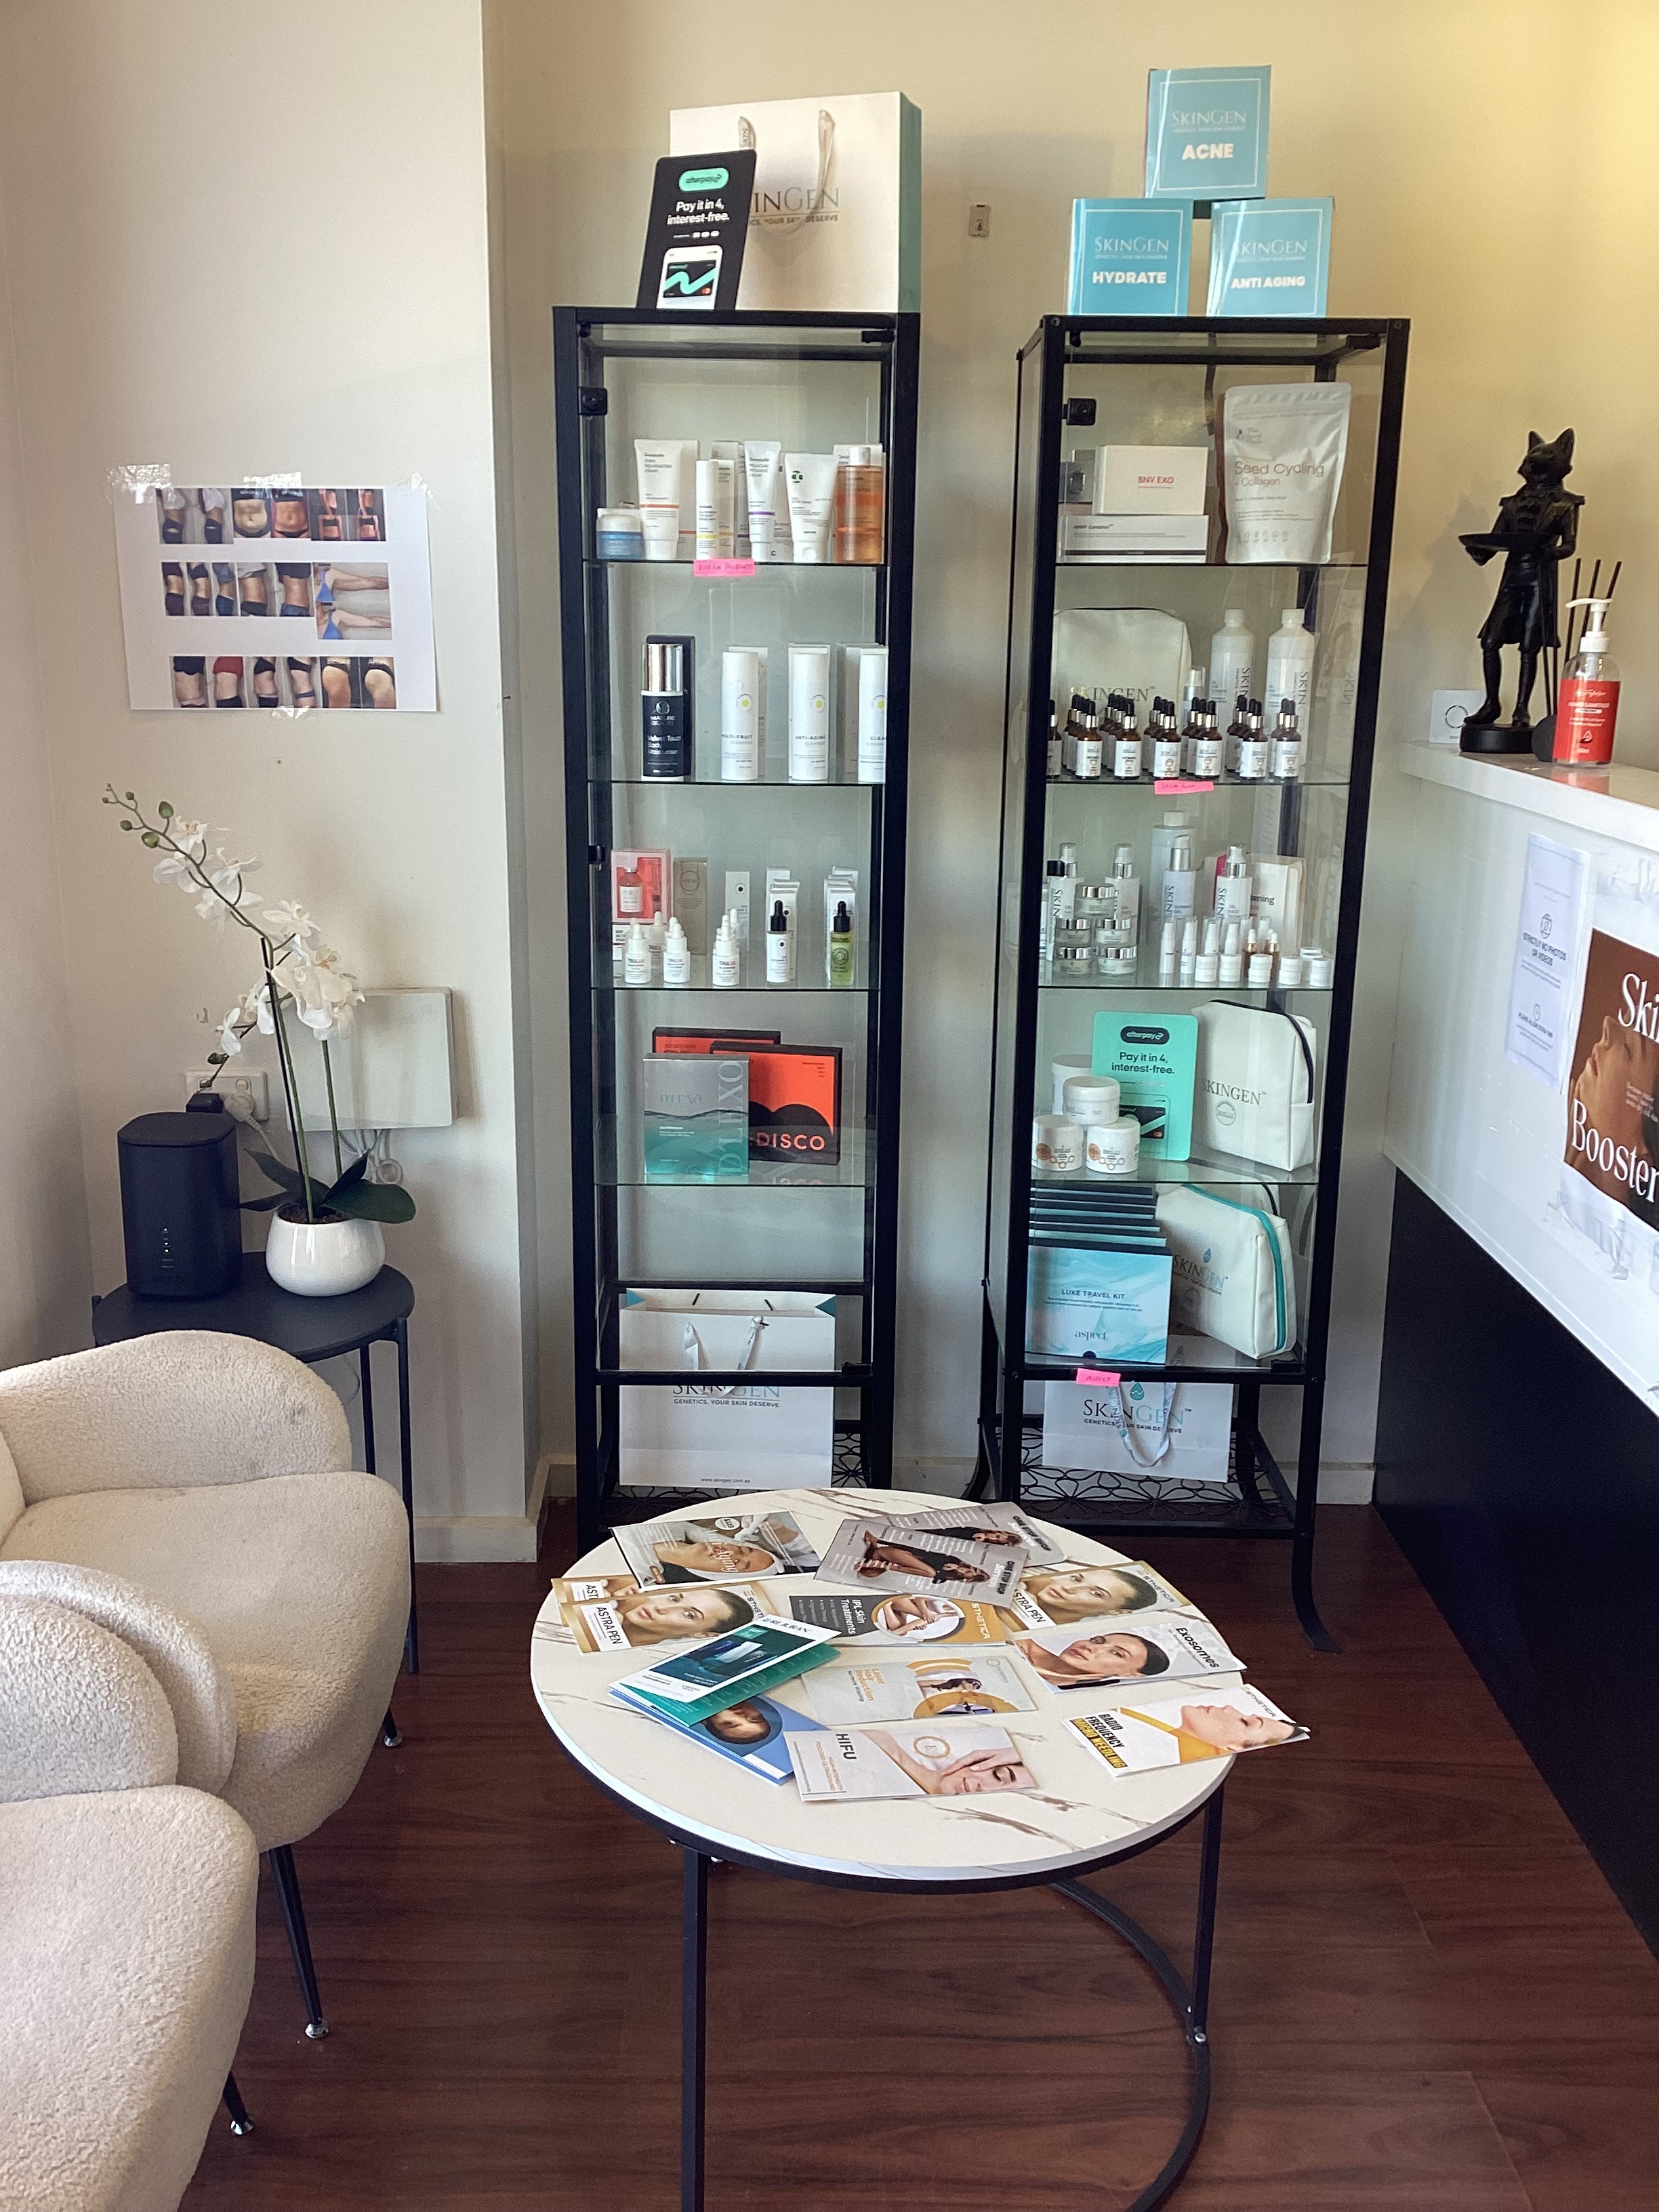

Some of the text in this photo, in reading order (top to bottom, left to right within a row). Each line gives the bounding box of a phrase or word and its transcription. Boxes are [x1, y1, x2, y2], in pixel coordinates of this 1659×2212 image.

[1181, 143, 1233, 160] ACNE
[676, 201, 697, 213] Pay
[697, 199, 704, 210] it
[704, 198, 714, 209] in
[754, 187, 840, 213] INGEN
[667, 212, 730, 225] interest-free.
[1092, 271, 1167, 285] HYDRATE
[1230, 276, 1306, 289] ANTI AGING
[1235, 461, 1325, 478] Seed Cycling
[1241, 476, 1280, 487] Collagen
[1126, 1031, 1155, 1040] afterpay
[1120, 1052, 1168, 1064] Pay it in 4,
[1111, 1062, 1175, 1074] interest-free.
[756, 1132, 825, 1151] DISCO
[1083, 1398, 1184, 1426] SKNGEN
[586, 1584, 599, 1599] AST
[852, 1599, 867, 1624] IPL Skin
[1014, 1589, 1047, 1622] STRA PEN
[596, 1607, 623, 1645] ASTRA PEN
[840, 1599, 857, 1635] Treatments
[1175, 1627, 1220, 1668] Exosomes
[855, 1669, 874, 1701] Reduction
[1098, 1713, 1124, 1731] RADIO
[1084, 1716, 1126, 1748] FREQUENCY
[835, 1734, 857, 1759] HIFU
[1090, 1736, 1127, 1768] NEEDLING
